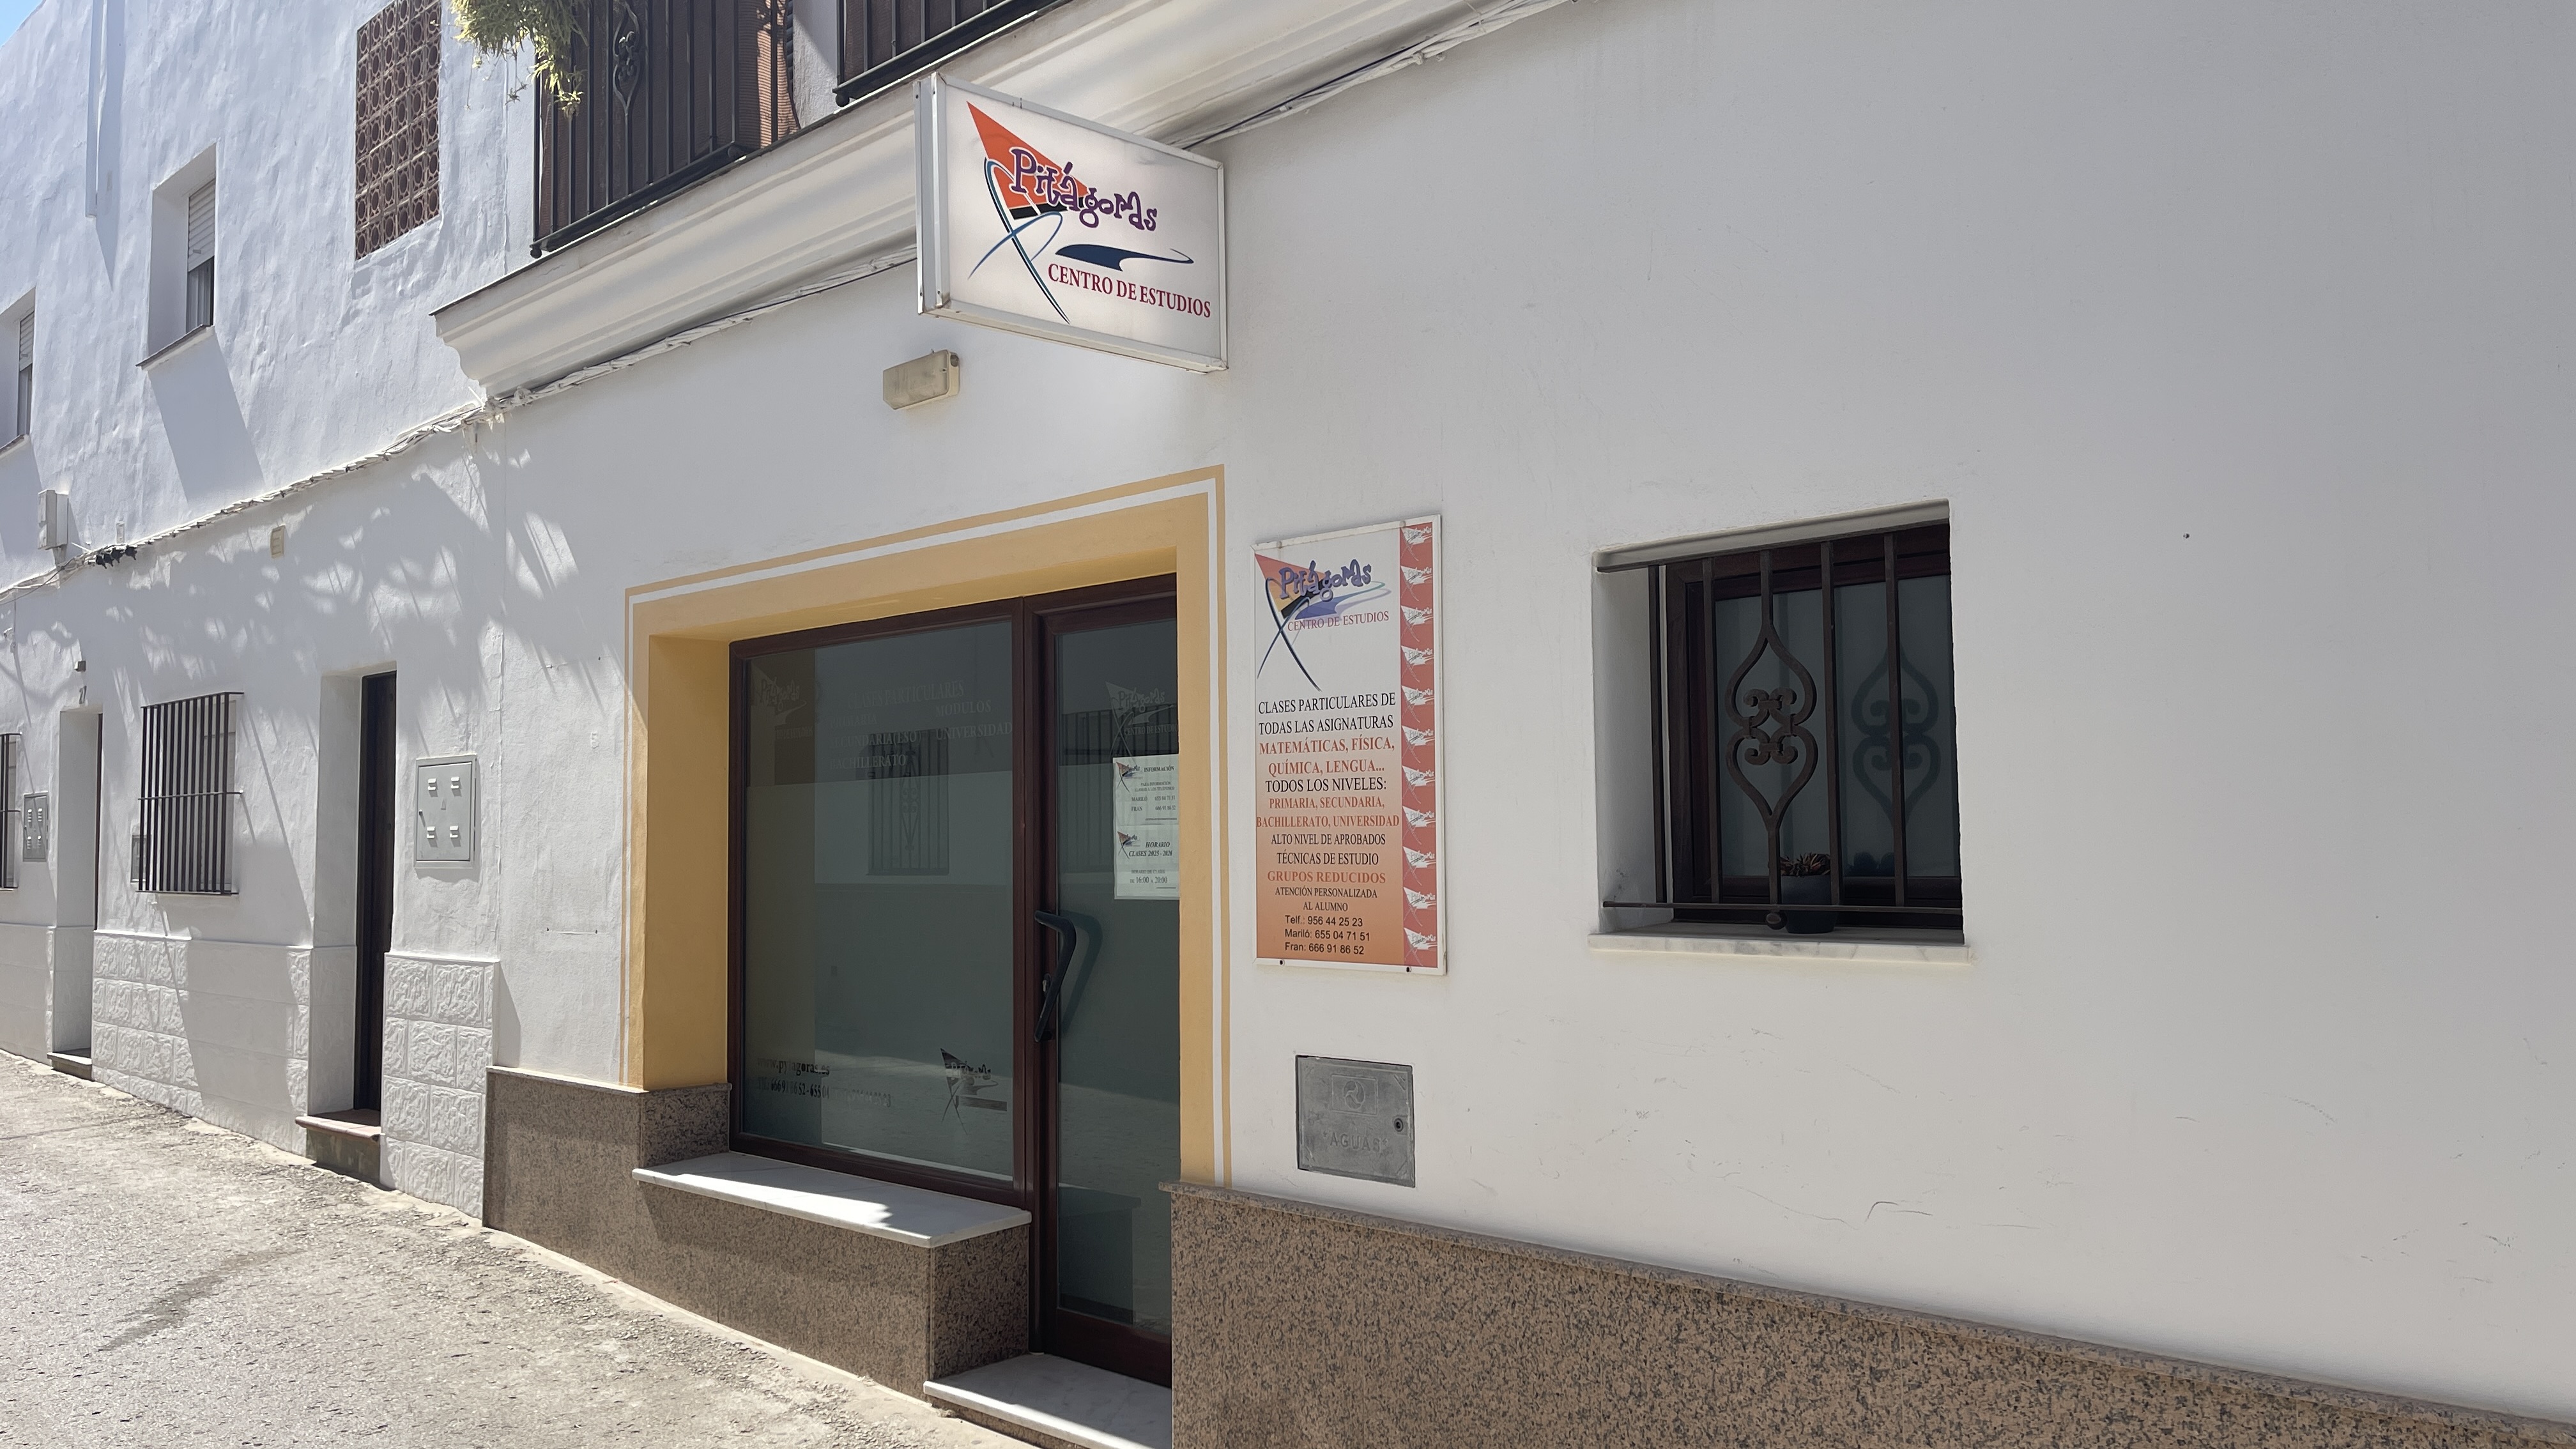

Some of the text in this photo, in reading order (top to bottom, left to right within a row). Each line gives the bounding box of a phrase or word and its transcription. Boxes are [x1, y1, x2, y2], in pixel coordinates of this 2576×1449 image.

[1009, 148, 1157, 231] Pitágoras
[1048, 264, 1211, 318] CENTRO DE ESTUDIOS
[1279, 559, 1372, 602] Pitágoras
[1287, 611, 1389, 632] CENTRO DE ESTUDIOS
[884, 680, 964, 706] PARTICULARES
[1259, 692, 1396, 714] CLASES PARTICULARES DE
[936, 721, 1013, 740] UNIVERSIDAD
[1155, 723, 1177, 734] ESTUDIO
[1259, 721, 1292, 735] TODAS
[1294, 719, 1314, 733] LAS
[1317, 714, 1393, 732] ASIGNATURAS
[1259, 734, 1395, 755] MATEMÁTICAS, FÍSICA,
[1268, 758, 1384, 777] QUÍMICA, LENGUA...
[1266, 776, 1386, 793] TODOS LOS NIVELES:
[1269, 796, 1385, 810] PRIMARIA, SECUNDARIA,
[1256, 814, 1400, 829] BACHILLERATO, UNIVERSIDAD
[1271, 834, 1386, 845] ALTO NIVEL DE APROBADOS
[1276, 848, 1379, 865] TÉCNICAS DE ESTUDIO
[1268, 871, 1386, 884] GRUPOS REDUCIDOS
[1275, 884, 1377, 898] ATENCIÓN PERSONALIZADA
[1303, 901, 1348, 912] AL ALUMNO
[1285, 914, 1363, 927] Telf.: 956 44 25 23
[1285, 928, 1370, 941] Mariló: 655 04 71 51
[1285, 942, 1364, 955] Fran: 666 91 86 52
